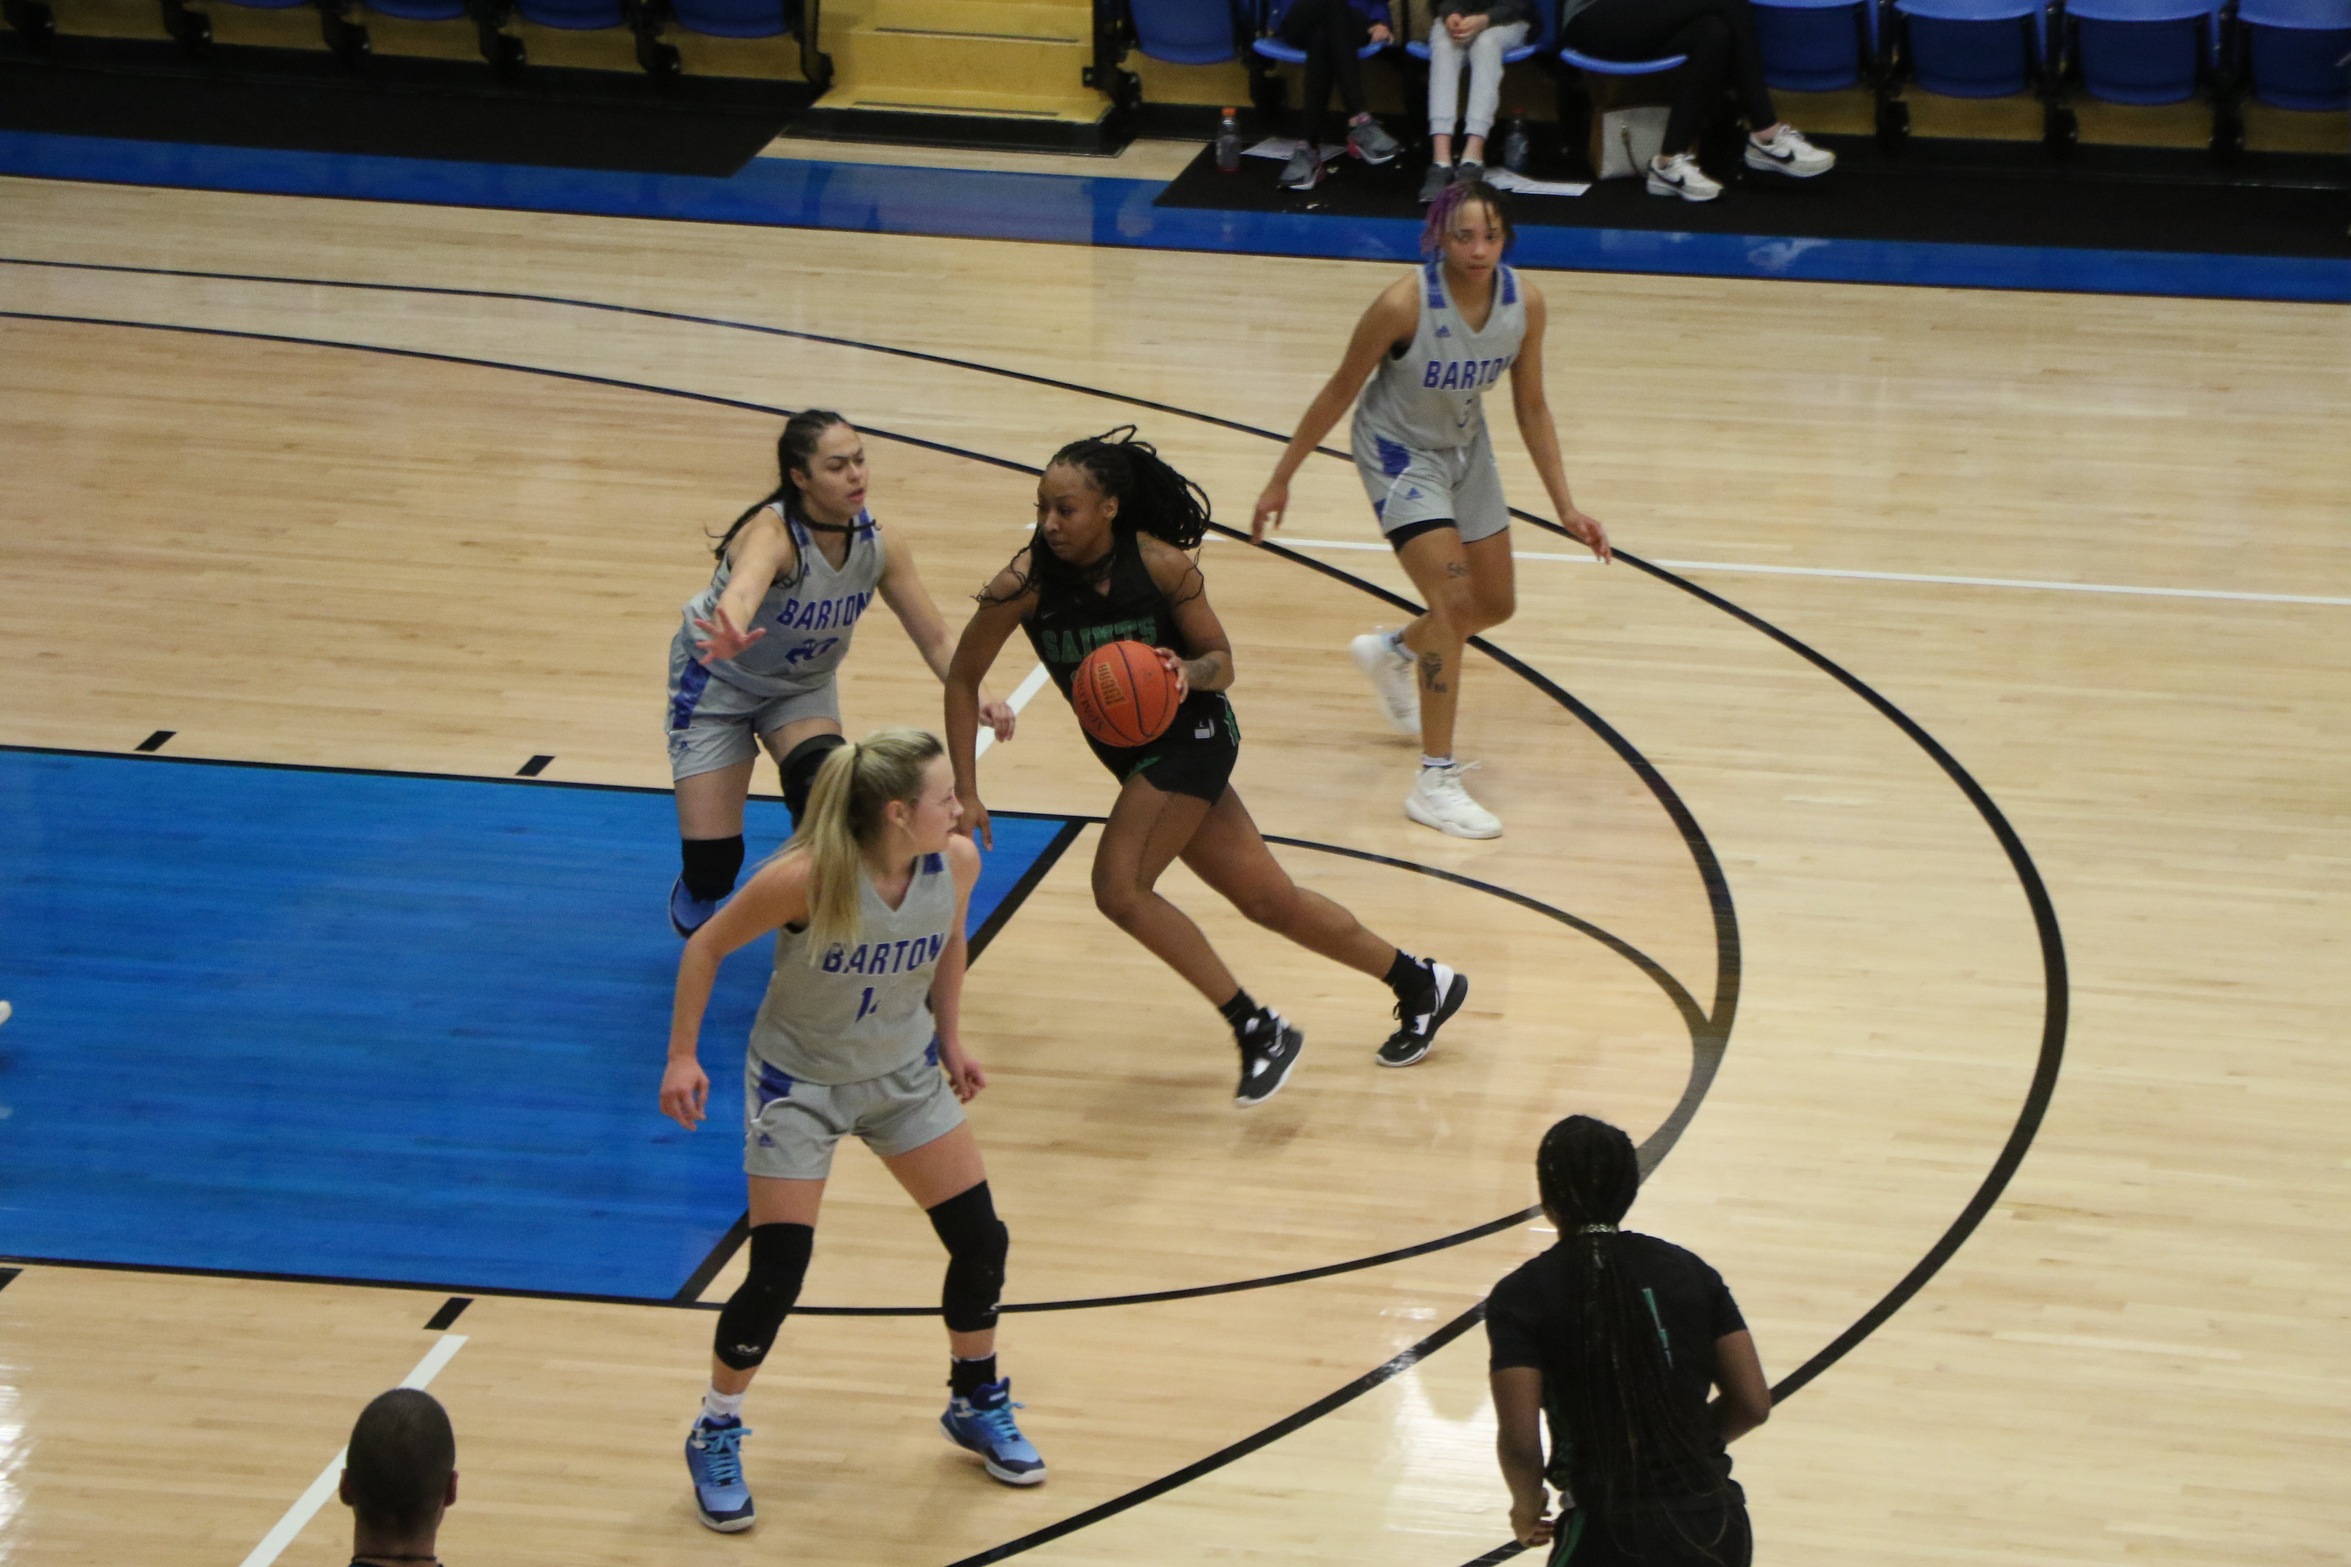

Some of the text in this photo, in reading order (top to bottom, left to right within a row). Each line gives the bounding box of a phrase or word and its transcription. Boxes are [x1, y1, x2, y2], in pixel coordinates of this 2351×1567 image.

[1423, 355, 1514, 390] BARTO
[776, 592, 871, 630] BARTON
[822, 933, 945, 974] BARTON
